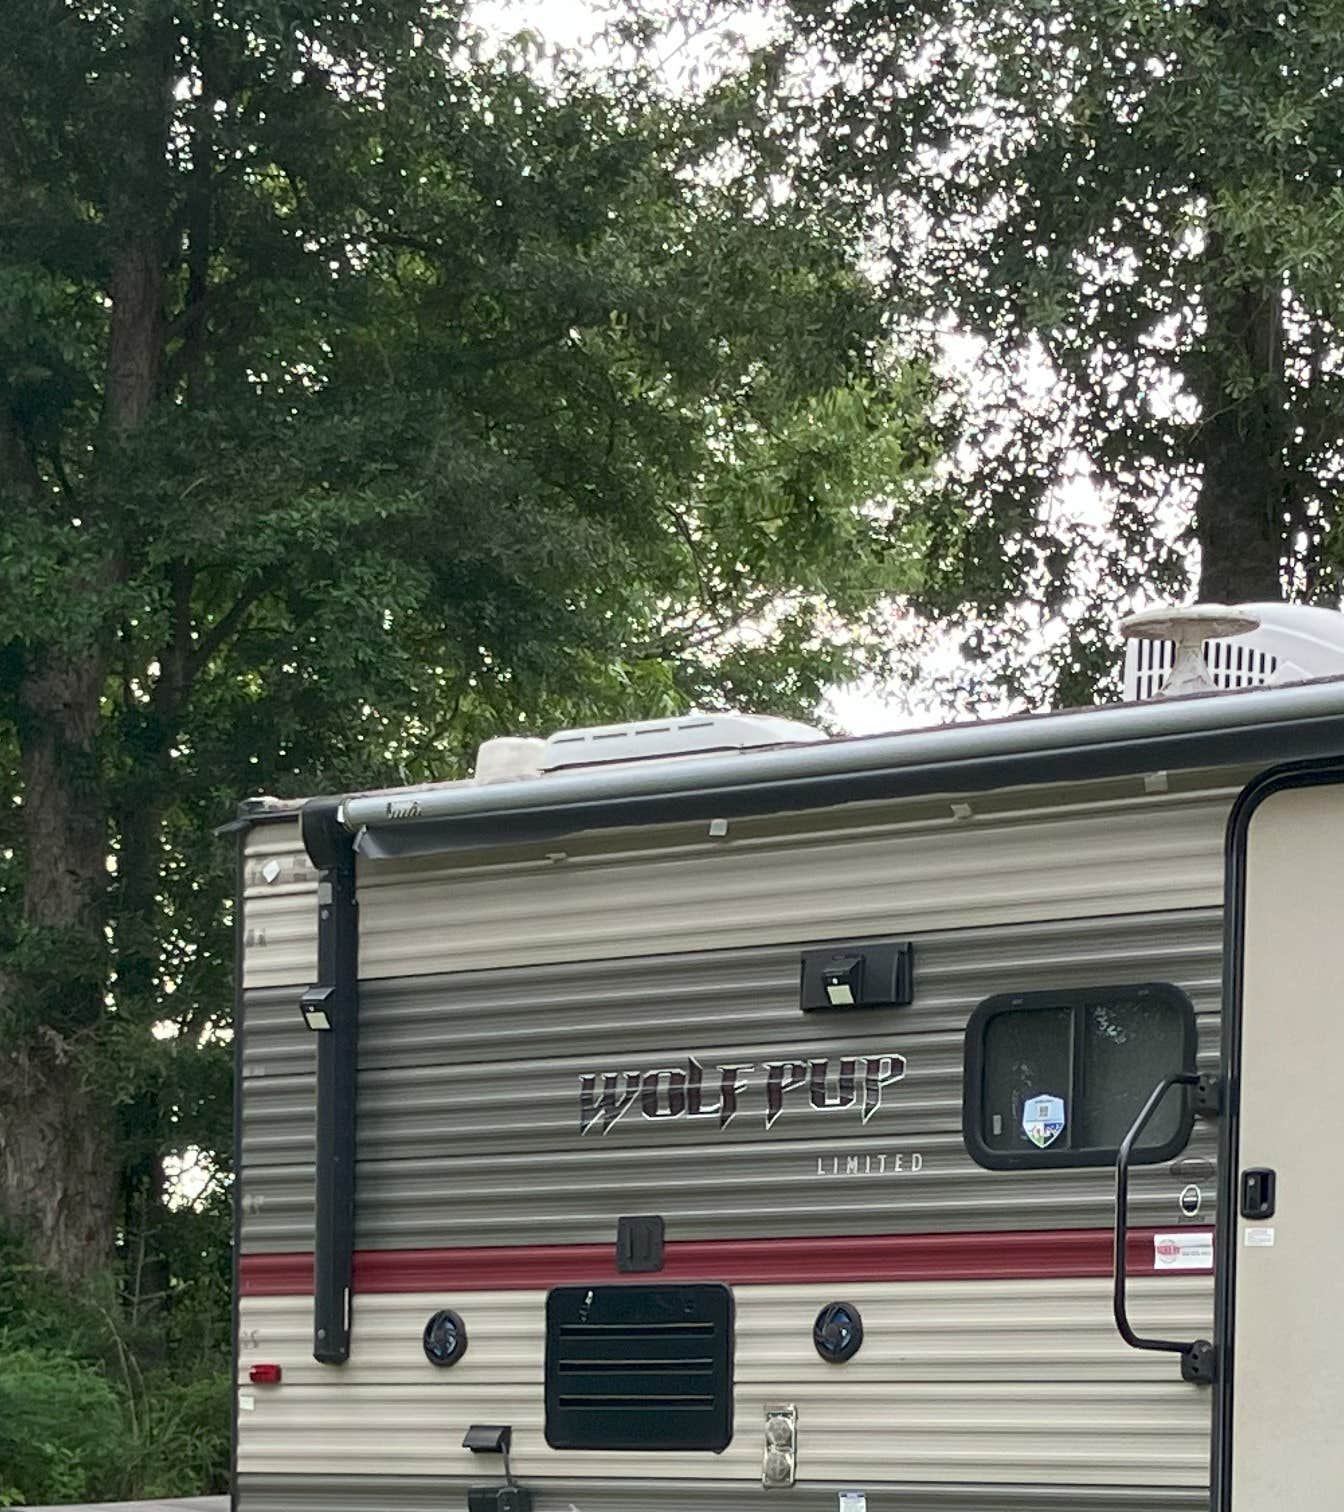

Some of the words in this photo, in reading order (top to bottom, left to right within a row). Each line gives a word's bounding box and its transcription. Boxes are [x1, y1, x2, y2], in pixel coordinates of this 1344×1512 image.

[579, 1056, 755, 1136] WOLF
[762, 1054, 906, 1130] PUP
[817, 1153, 923, 1175] LIMITED
